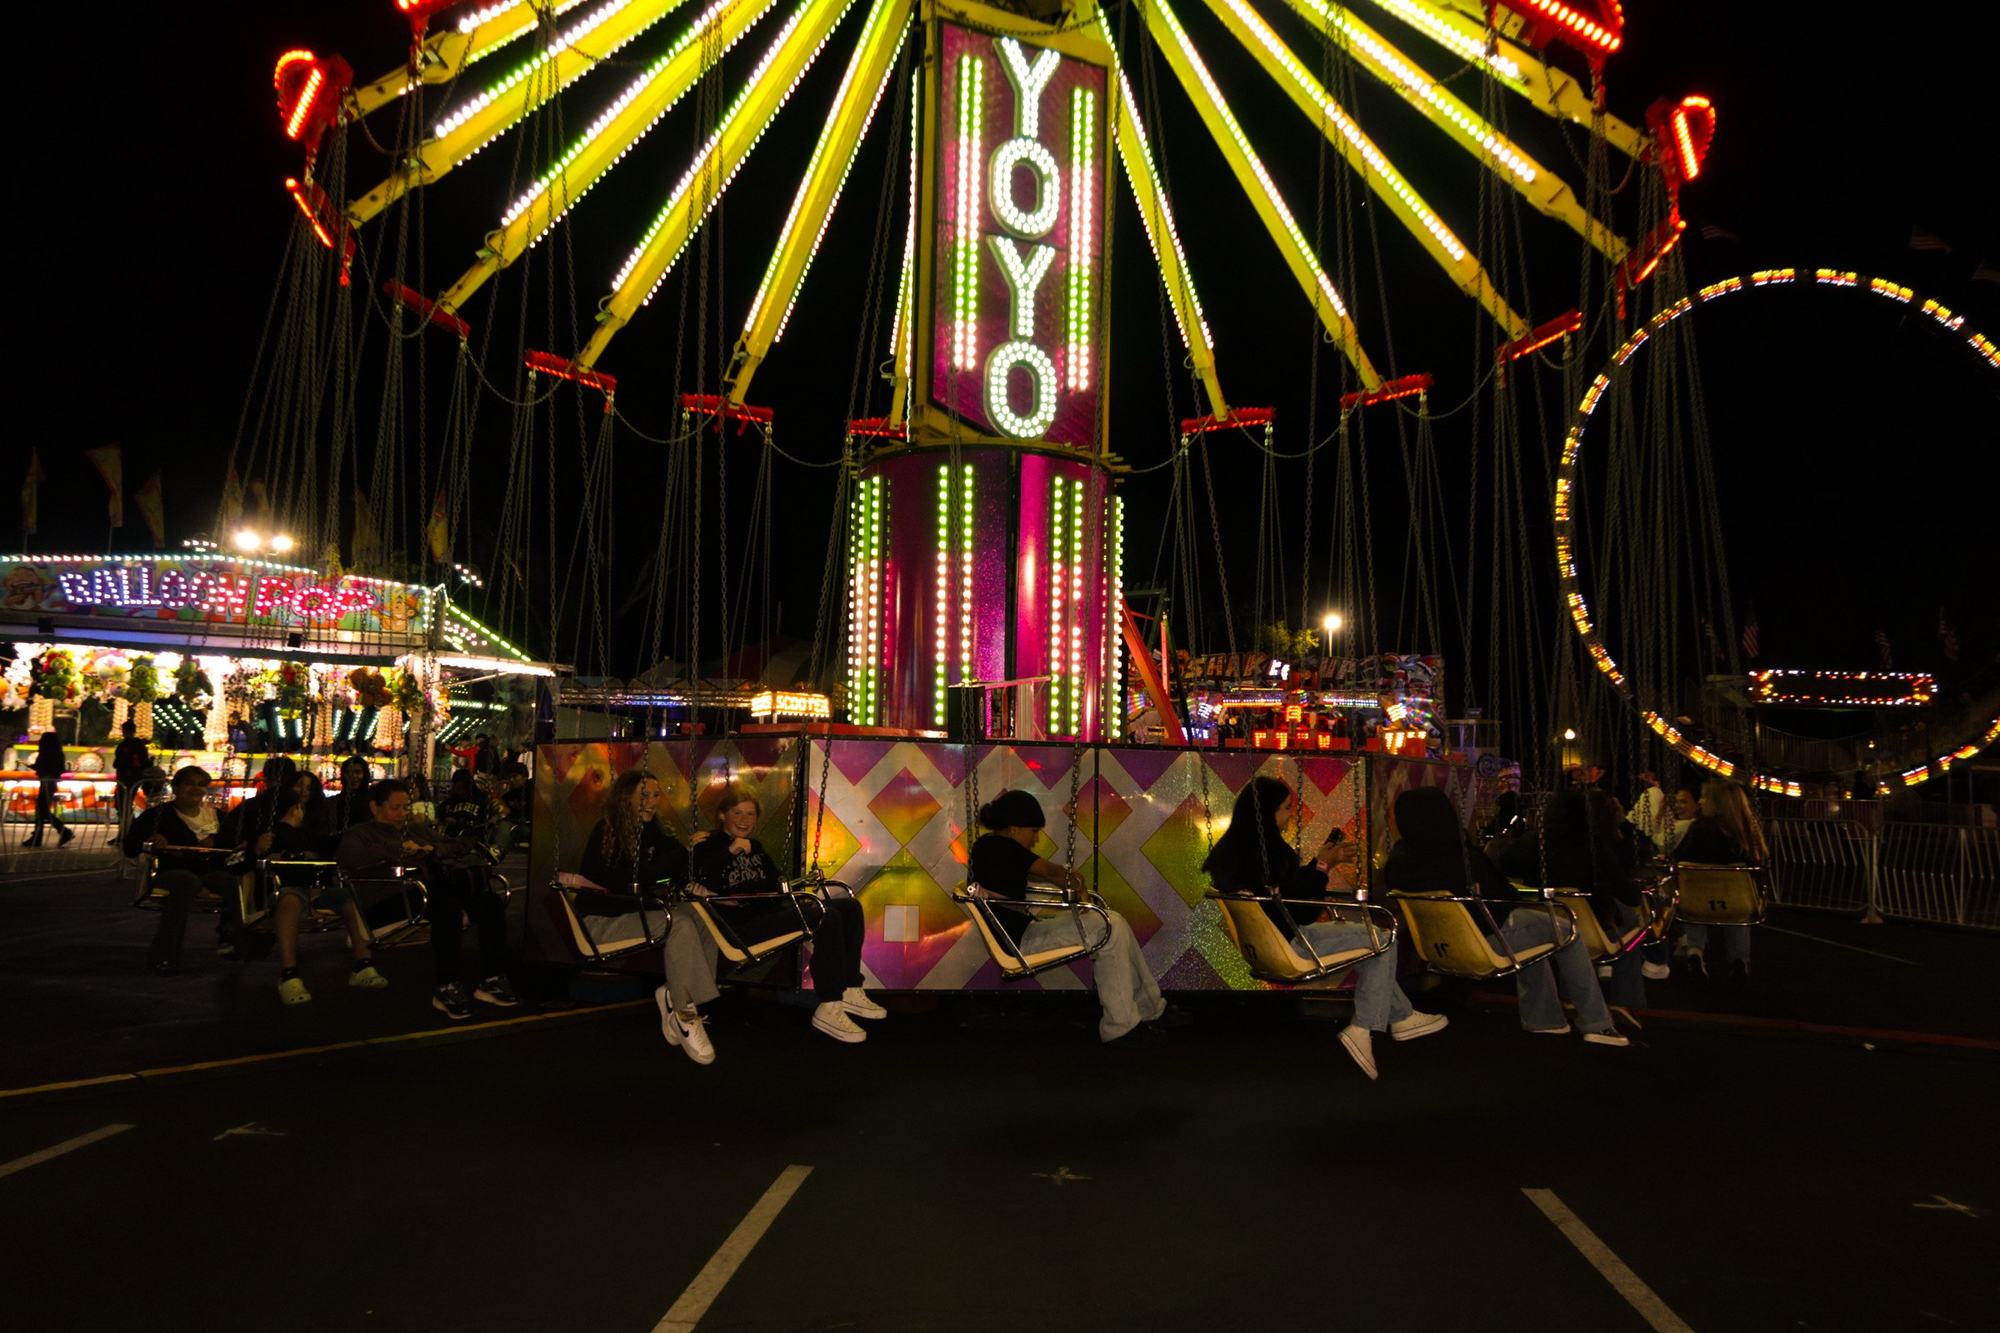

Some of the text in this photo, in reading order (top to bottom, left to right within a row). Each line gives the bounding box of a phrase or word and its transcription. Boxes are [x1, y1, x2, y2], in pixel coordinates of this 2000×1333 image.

[986, 36, 1061, 439] YOYO
[58, 566, 377, 619] BALLOON POP
